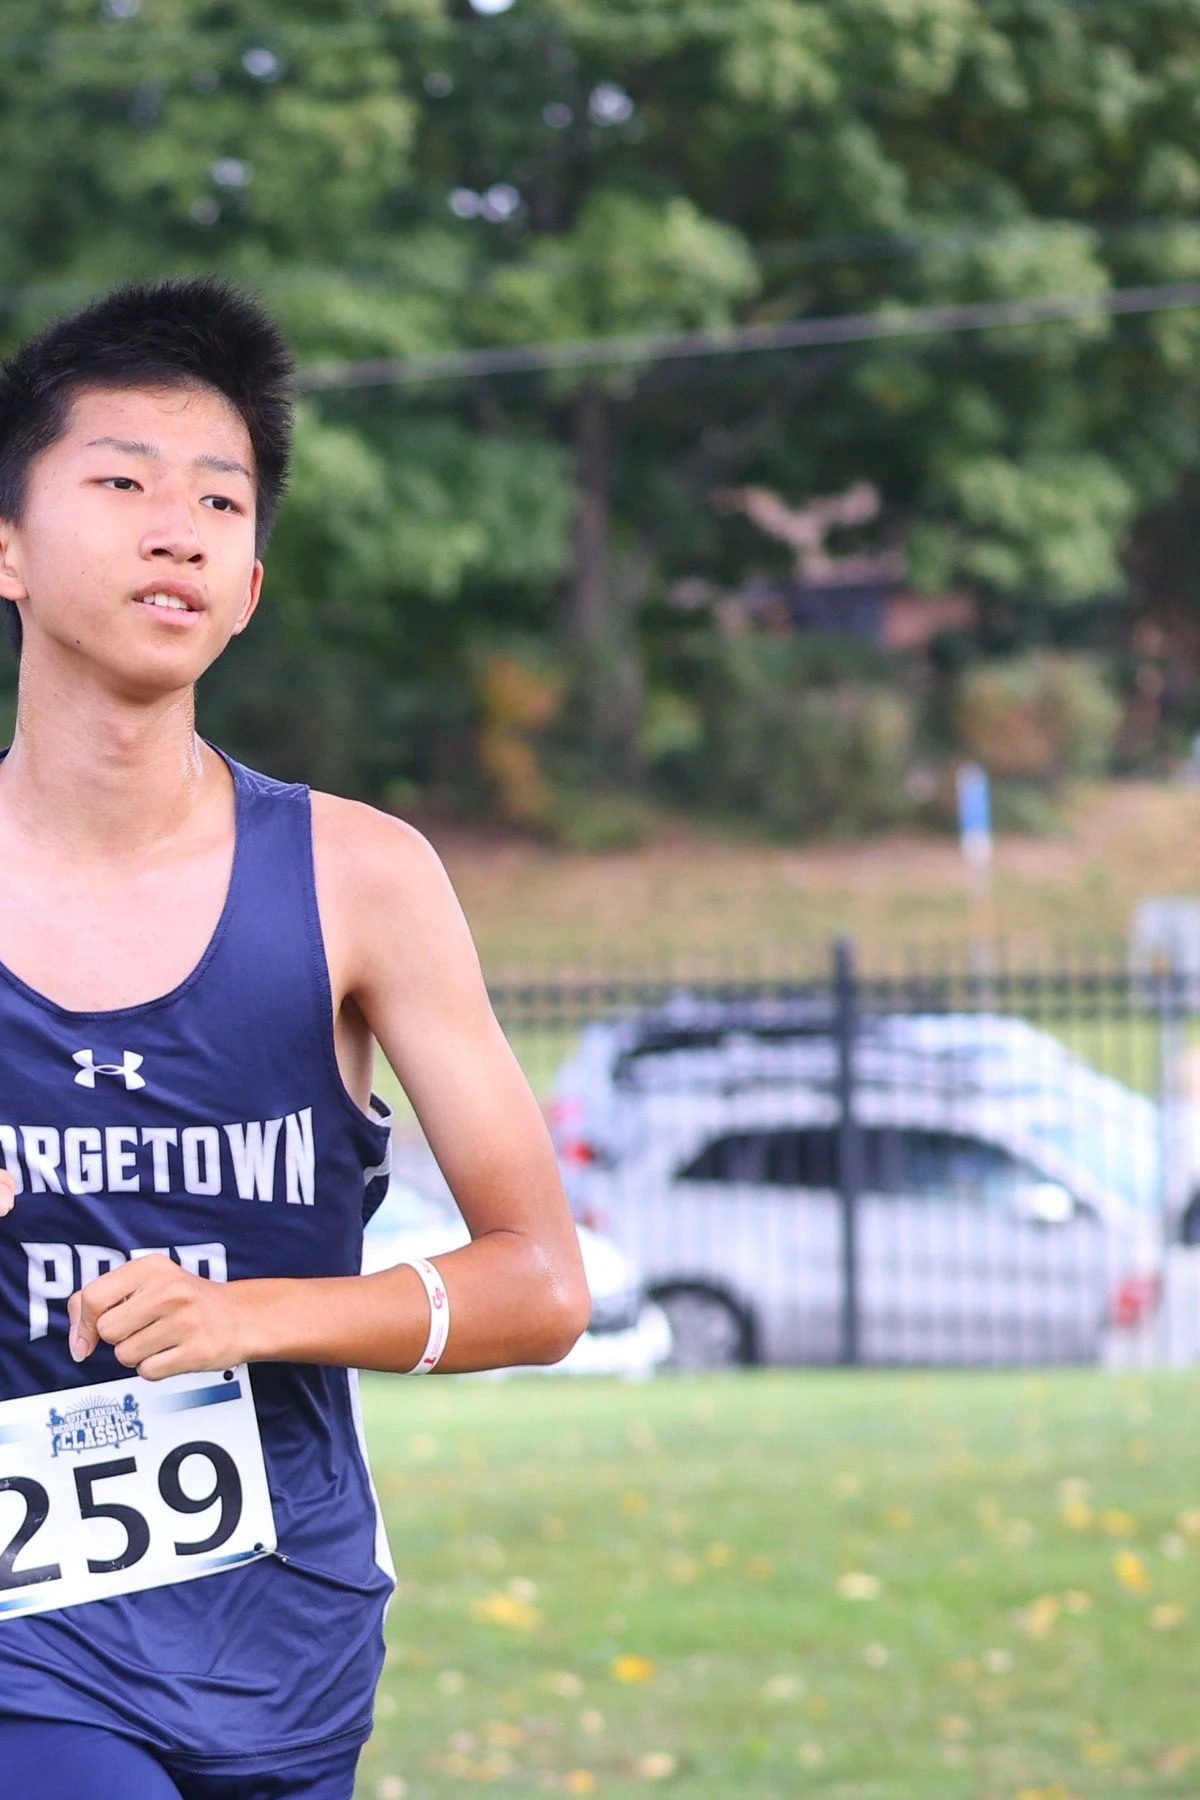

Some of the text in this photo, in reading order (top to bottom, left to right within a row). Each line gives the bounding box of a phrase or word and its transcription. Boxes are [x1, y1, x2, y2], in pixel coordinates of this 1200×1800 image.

[53, 1411, 138, 1433] GEORGETOWN PREP
[89, 1405, 121, 1418] ANNUAL
[60, 1421, 136, 1449] CLASSIC
